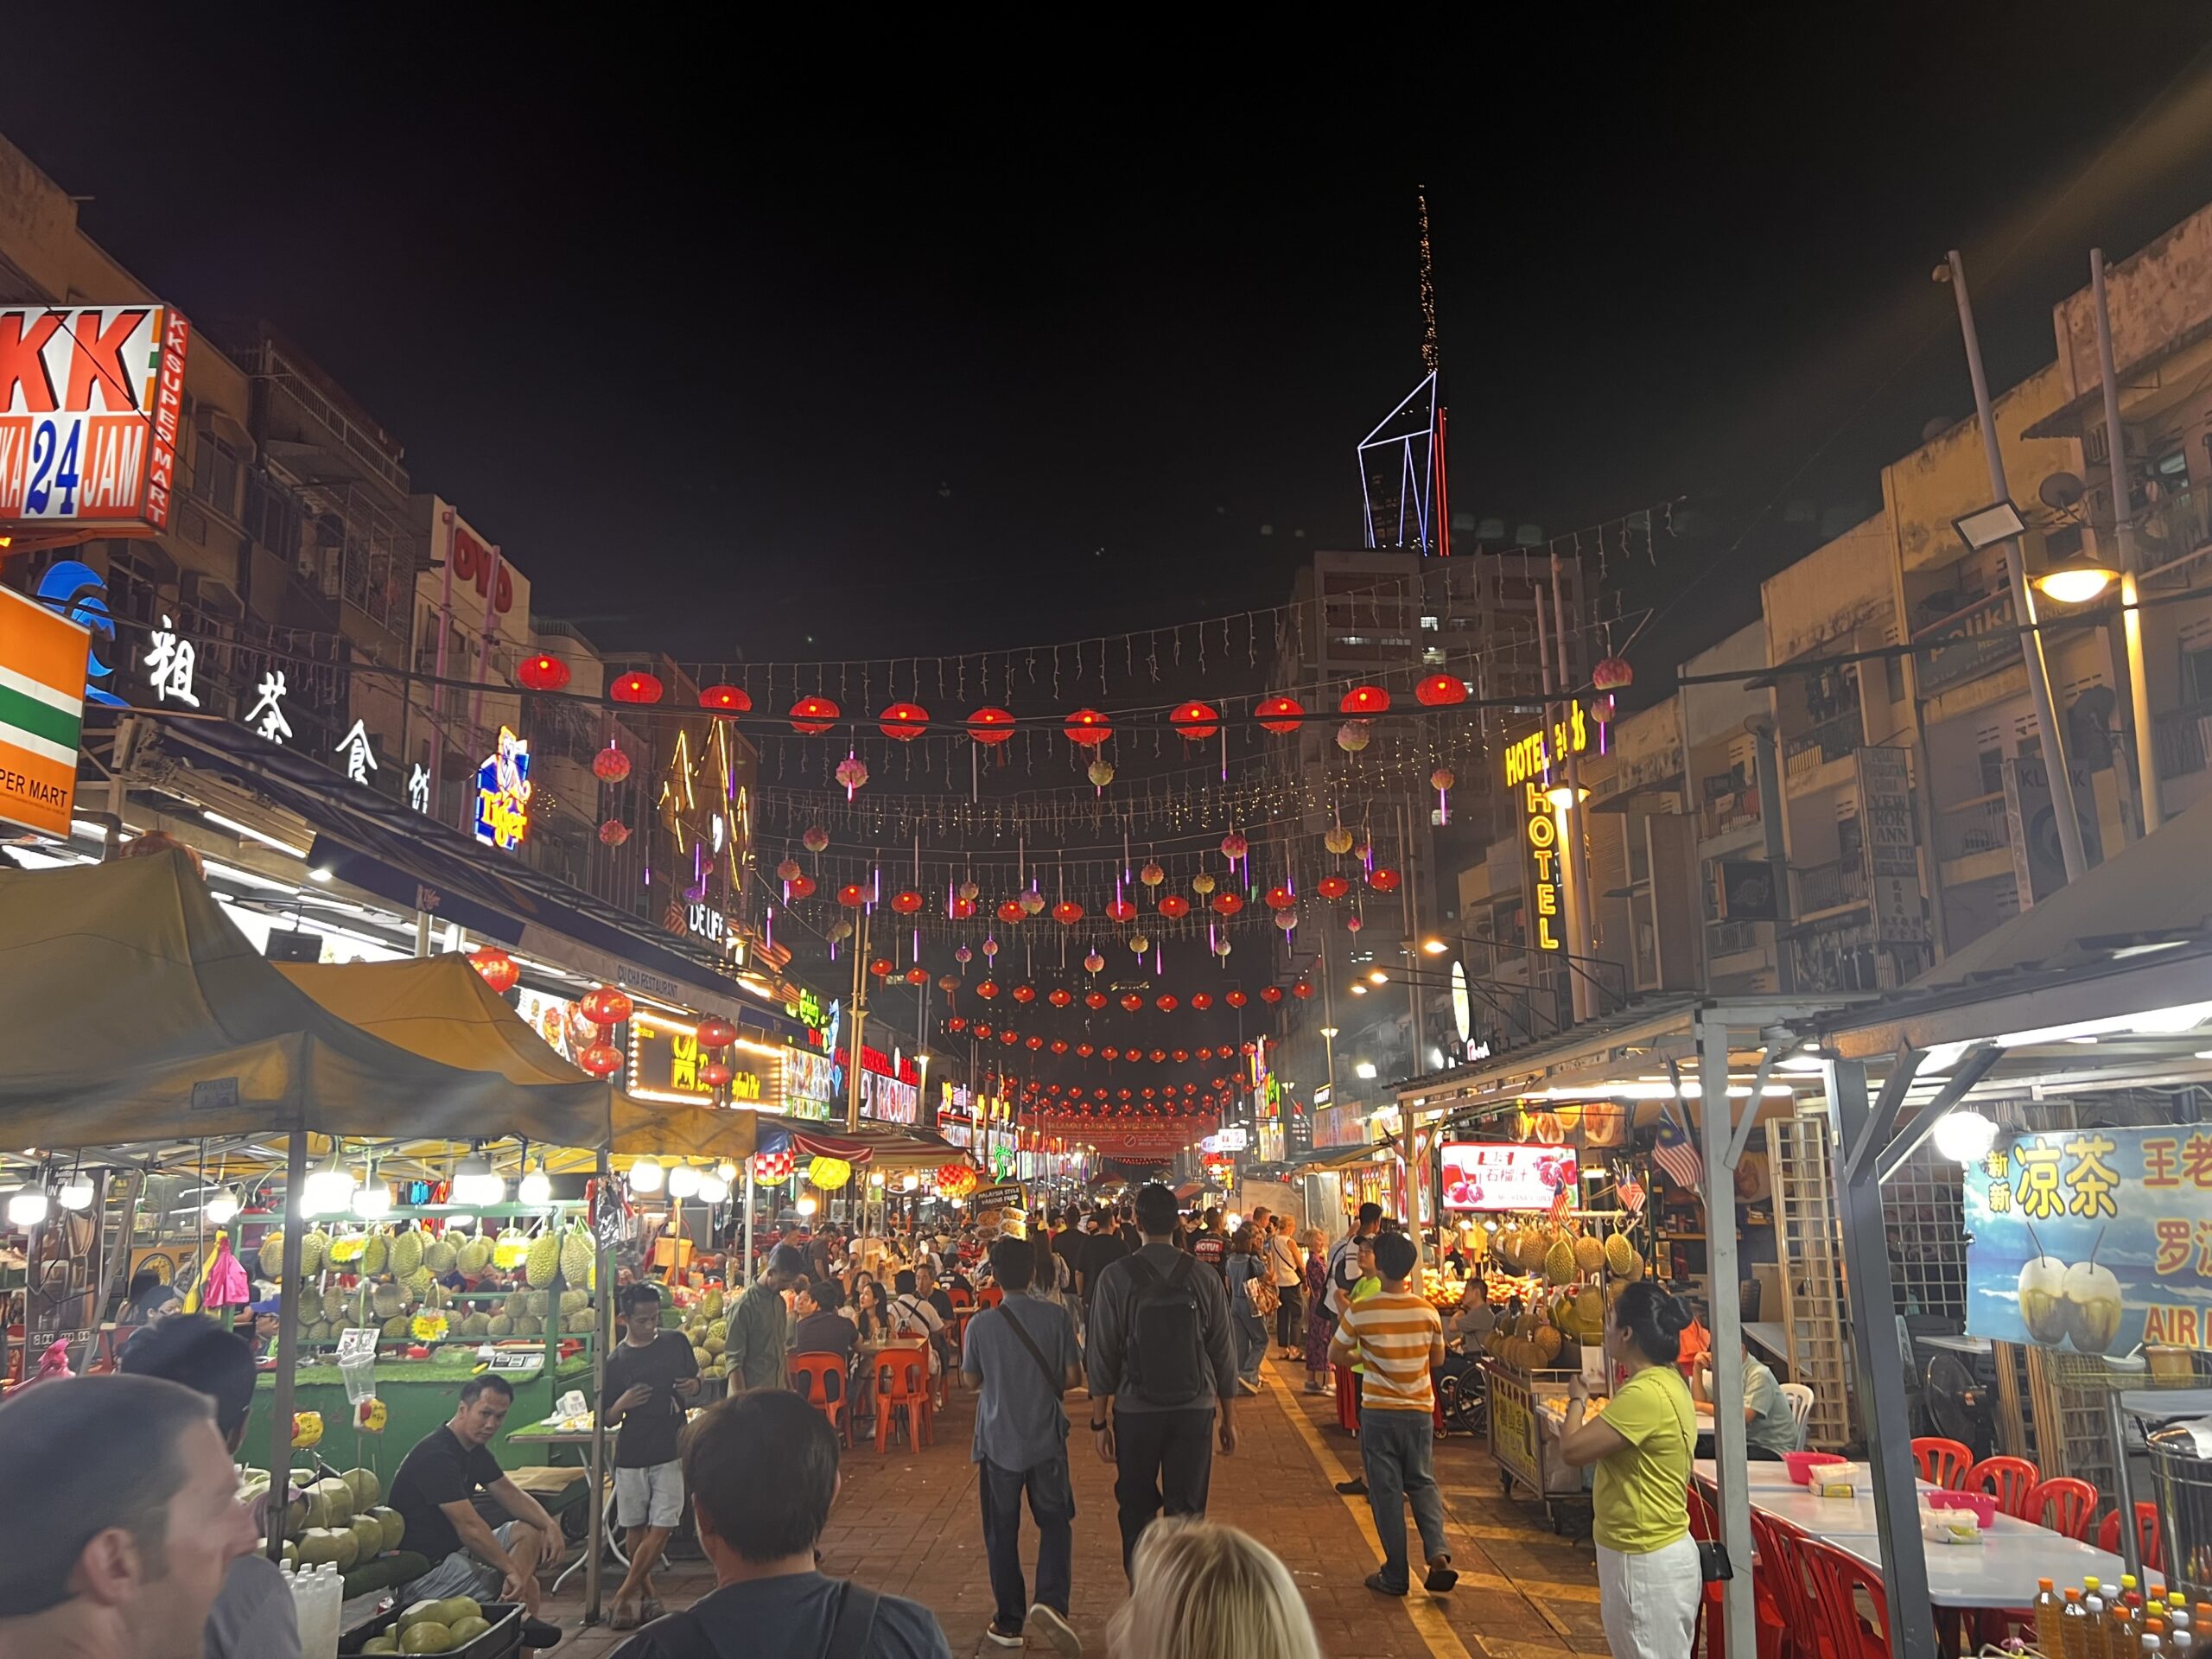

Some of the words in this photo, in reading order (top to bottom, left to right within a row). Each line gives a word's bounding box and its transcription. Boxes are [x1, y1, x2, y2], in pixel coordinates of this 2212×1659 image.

[0, 309, 151, 412] KK
[0, 426, 26, 508] KA
[25, 419, 81, 515] 24
[83, 425, 144, 508] JAM
[454, 528, 512, 613] OYO
[1505, 730, 1550, 787] HOTEL
[2021, 768, 2087, 788] KLK
[29, 779, 67, 808] MART
[480, 788, 528, 848] Tiger
[1874, 810, 1906, 827] KOK
[1876, 828, 1909, 843] ANN
[1527, 782, 1559, 950] HOTEL
[618, 963, 627, 981] CU
[628, 969, 640, 987] CHA
[640, 972, 678, 1000] RESTAURANT
[978, 1190, 1003, 1199] MALAYSIA
[1987, 1150, 2012, 1213] 新新
[2013, 1135, 2120, 1220] 凉茶
[2145, 1306, 2198, 1347] AIR
